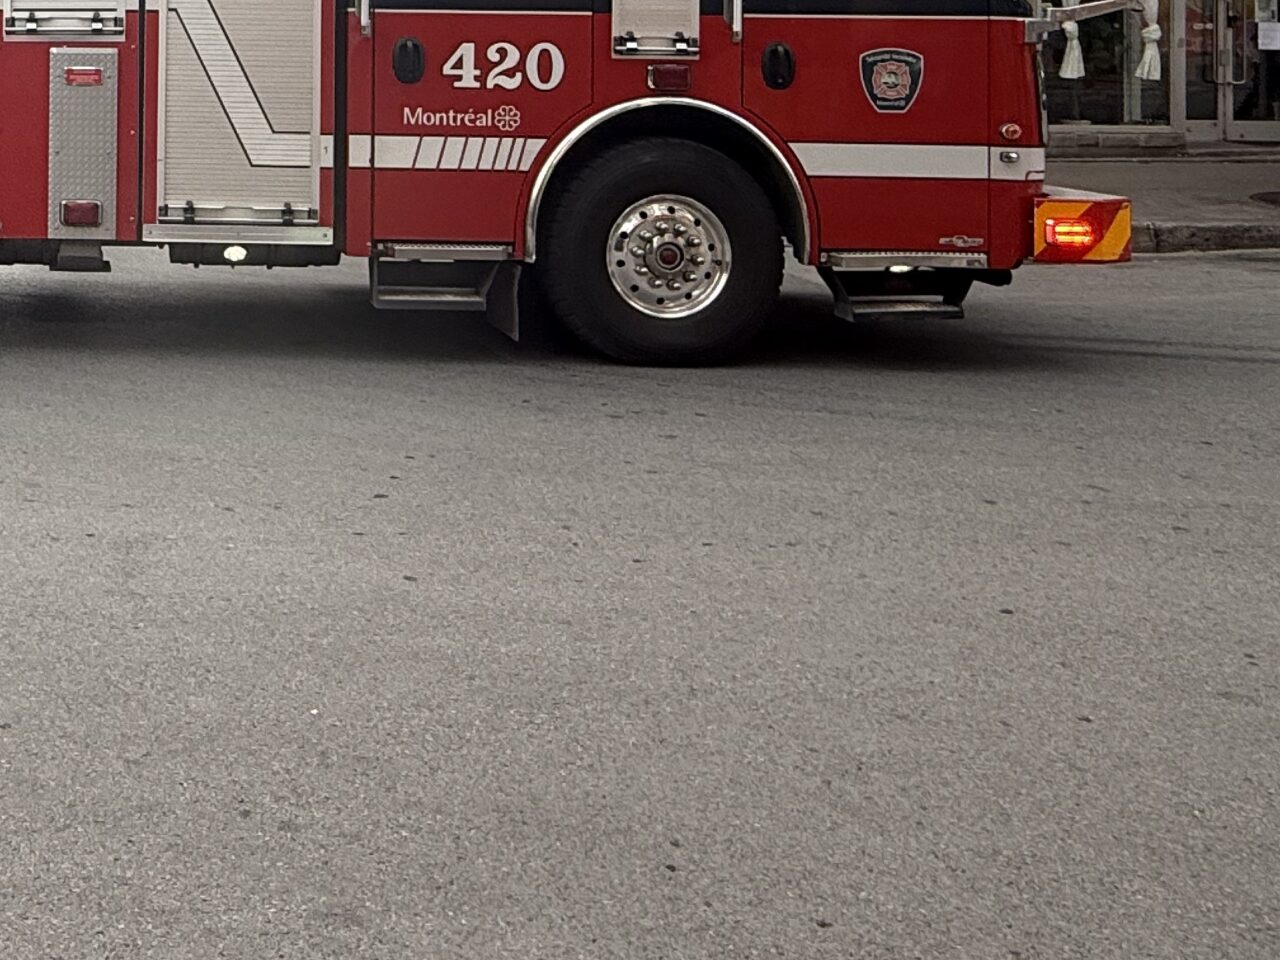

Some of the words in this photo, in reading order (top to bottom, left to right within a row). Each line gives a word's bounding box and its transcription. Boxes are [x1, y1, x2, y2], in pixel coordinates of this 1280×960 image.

[442, 41, 566, 91] 420
[403, 107, 492, 127] Montréal
[323, 145, 329, 155] 1
